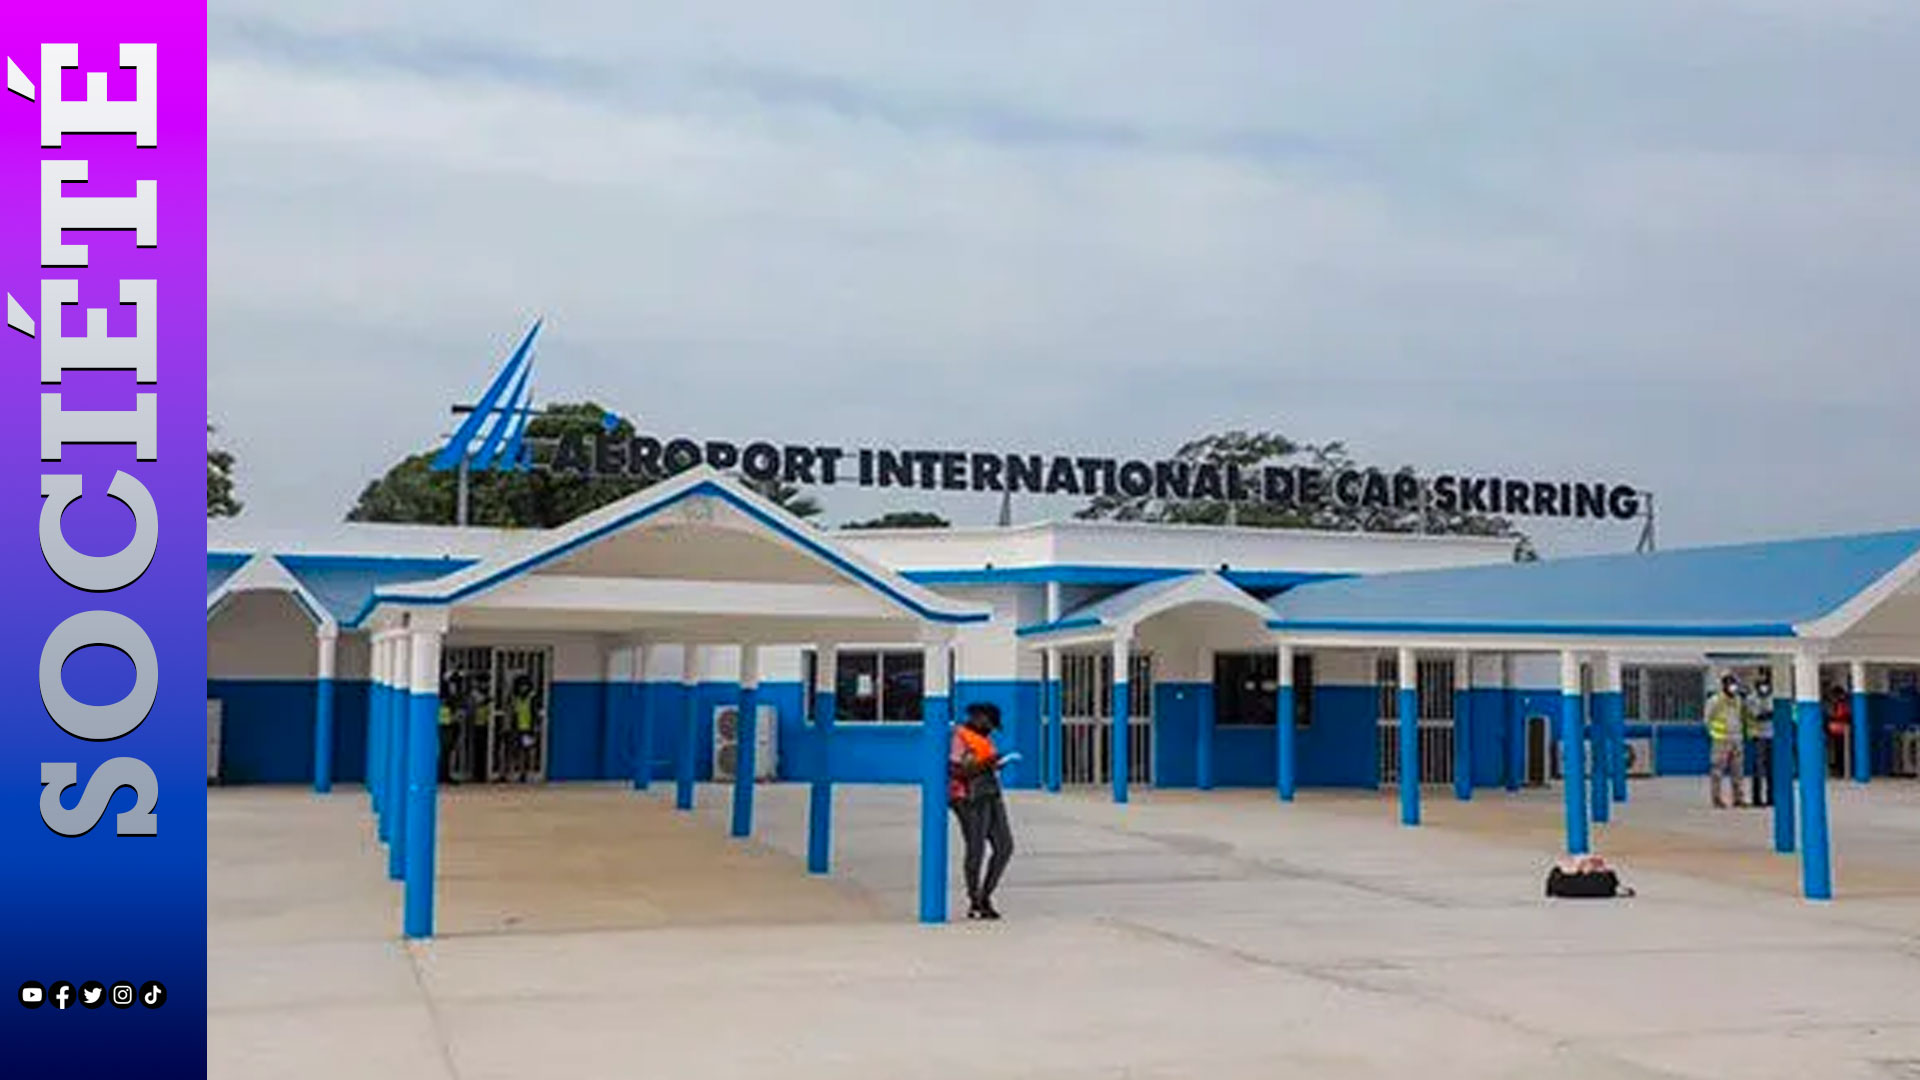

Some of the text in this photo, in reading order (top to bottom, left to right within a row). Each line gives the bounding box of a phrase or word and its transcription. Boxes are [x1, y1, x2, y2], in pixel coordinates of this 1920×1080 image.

[859, 449, 1247, 500] INTERNATIONAL
[1265, 466, 1321, 503] DE
[1335, 468, 1419, 508] CAP
[1434, 475, 1640, 519] SKIRRING
